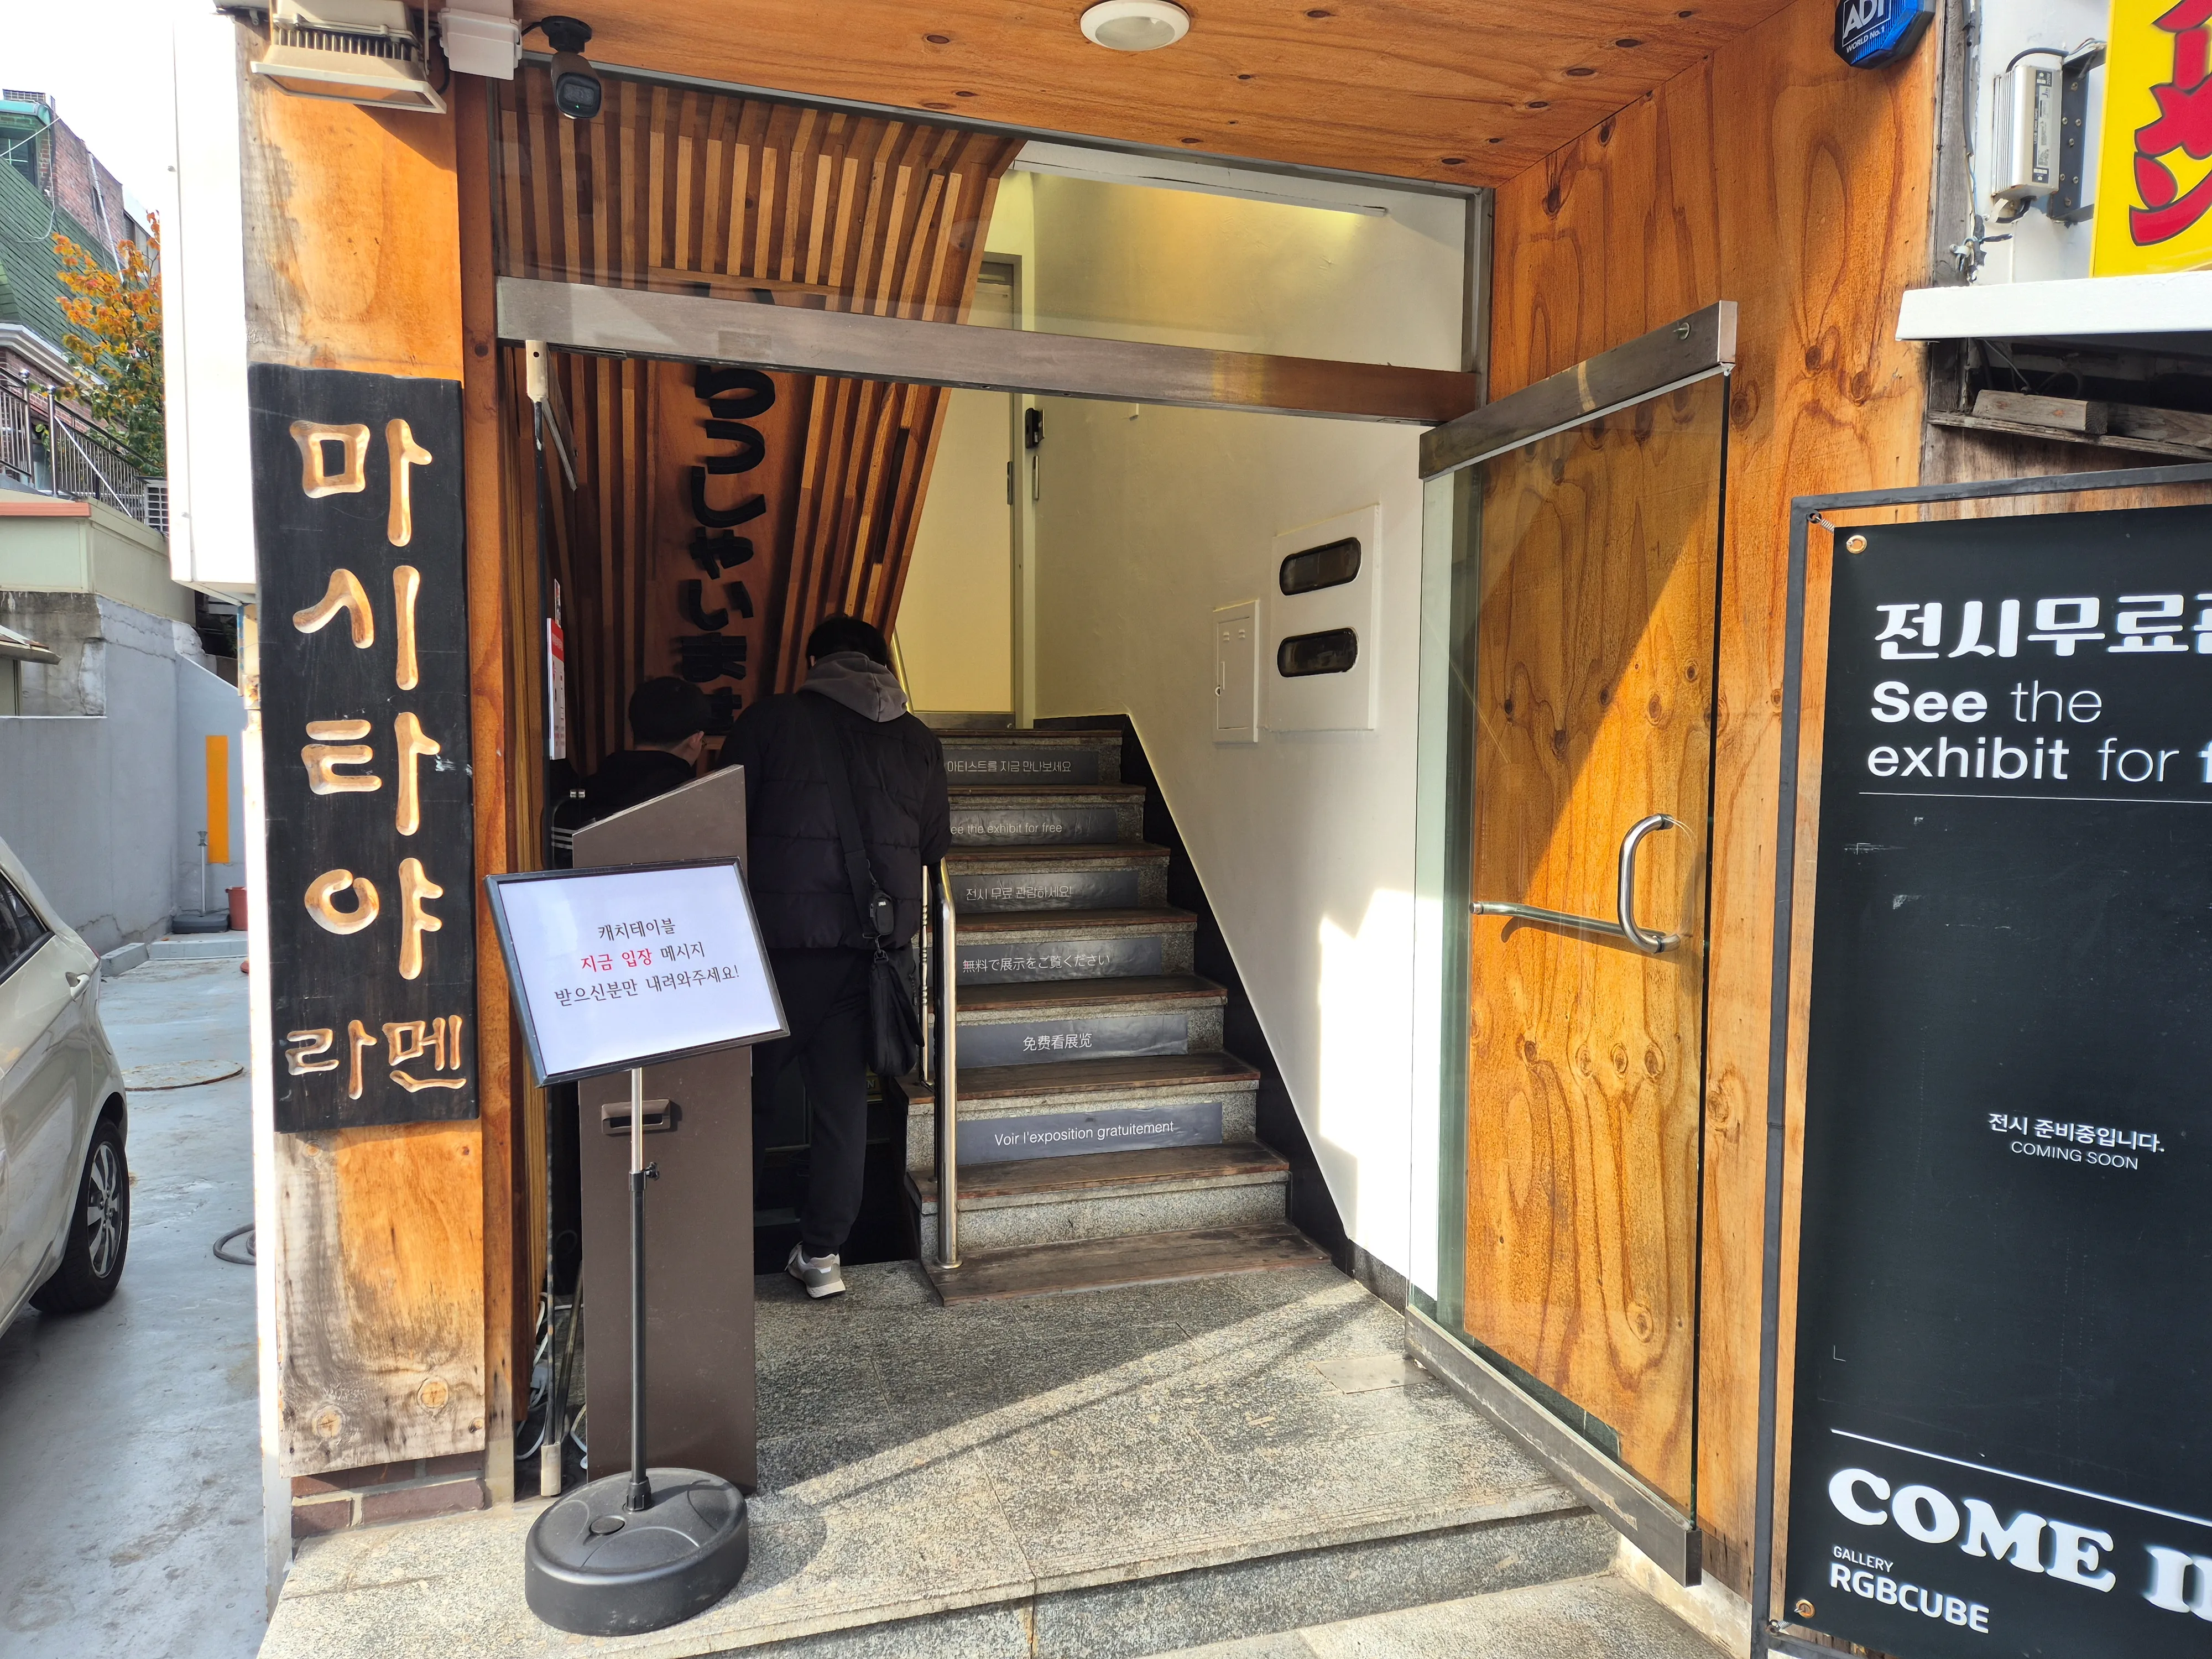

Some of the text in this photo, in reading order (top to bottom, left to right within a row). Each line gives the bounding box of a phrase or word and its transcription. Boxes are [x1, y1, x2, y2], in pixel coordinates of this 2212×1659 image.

[1846, 35, 1869, 54] WORLD
[290, 418, 444, 980] 마시타야
[1871, 680, 2102, 723] See the
[947, 760, 1071, 773] 아티스트를 지금 만나보세요
[1867, 736, 2069, 780] exhibit
[2098, 737, 2180, 782] for
[950, 822, 1062, 835] ee the exhibit for free
[966, 885, 1072, 901] 전시 무료 관람하세요!
[598, 918, 676, 941] 캐치테이블
[581, 941, 706, 973] 지금 입장 메시지
[962, 954, 1110, 973] 無料で展示をご覧ください
[554, 964, 740, 1007] 받으신분만 내려와주세요!
[1022, 1032, 1093, 1052] 免费看展览
[285, 1014, 466, 1100] 라멘
[994, 1120, 1174, 1146] Voir l'exposition gratuitement
[1988, 1113, 2165, 1153] 전시 준비중입니다.
[2011, 1141, 2139, 1170] COMING SOON
[1828, 1468, 2116, 1593] COME
[1833, 1545, 1893, 1573] GALLERY
[1830, 1563, 1990, 1635] RGBCUBE
